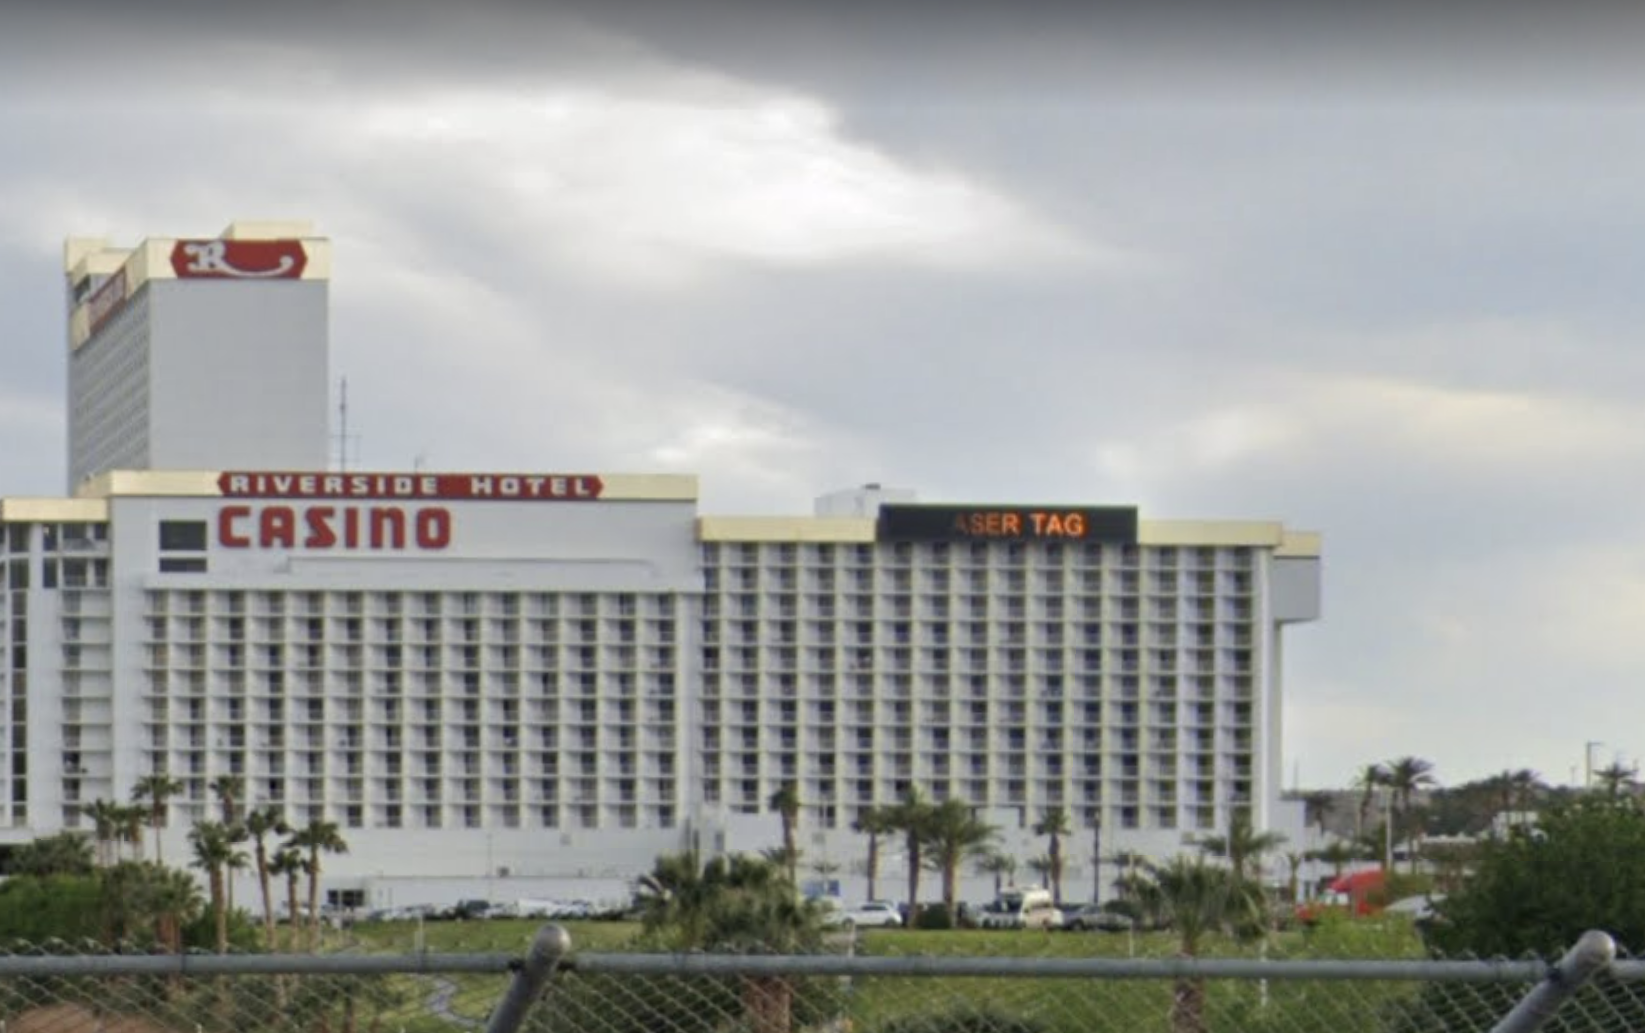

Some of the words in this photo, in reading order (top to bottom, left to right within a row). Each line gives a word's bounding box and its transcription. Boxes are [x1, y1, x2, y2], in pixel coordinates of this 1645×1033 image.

[229, 475, 438, 494] RIVERSIDE
[471, 476, 590, 495] HOTEL
[218, 506, 451, 549] CASINO
[1030, 513, 1084, 536] TAG
